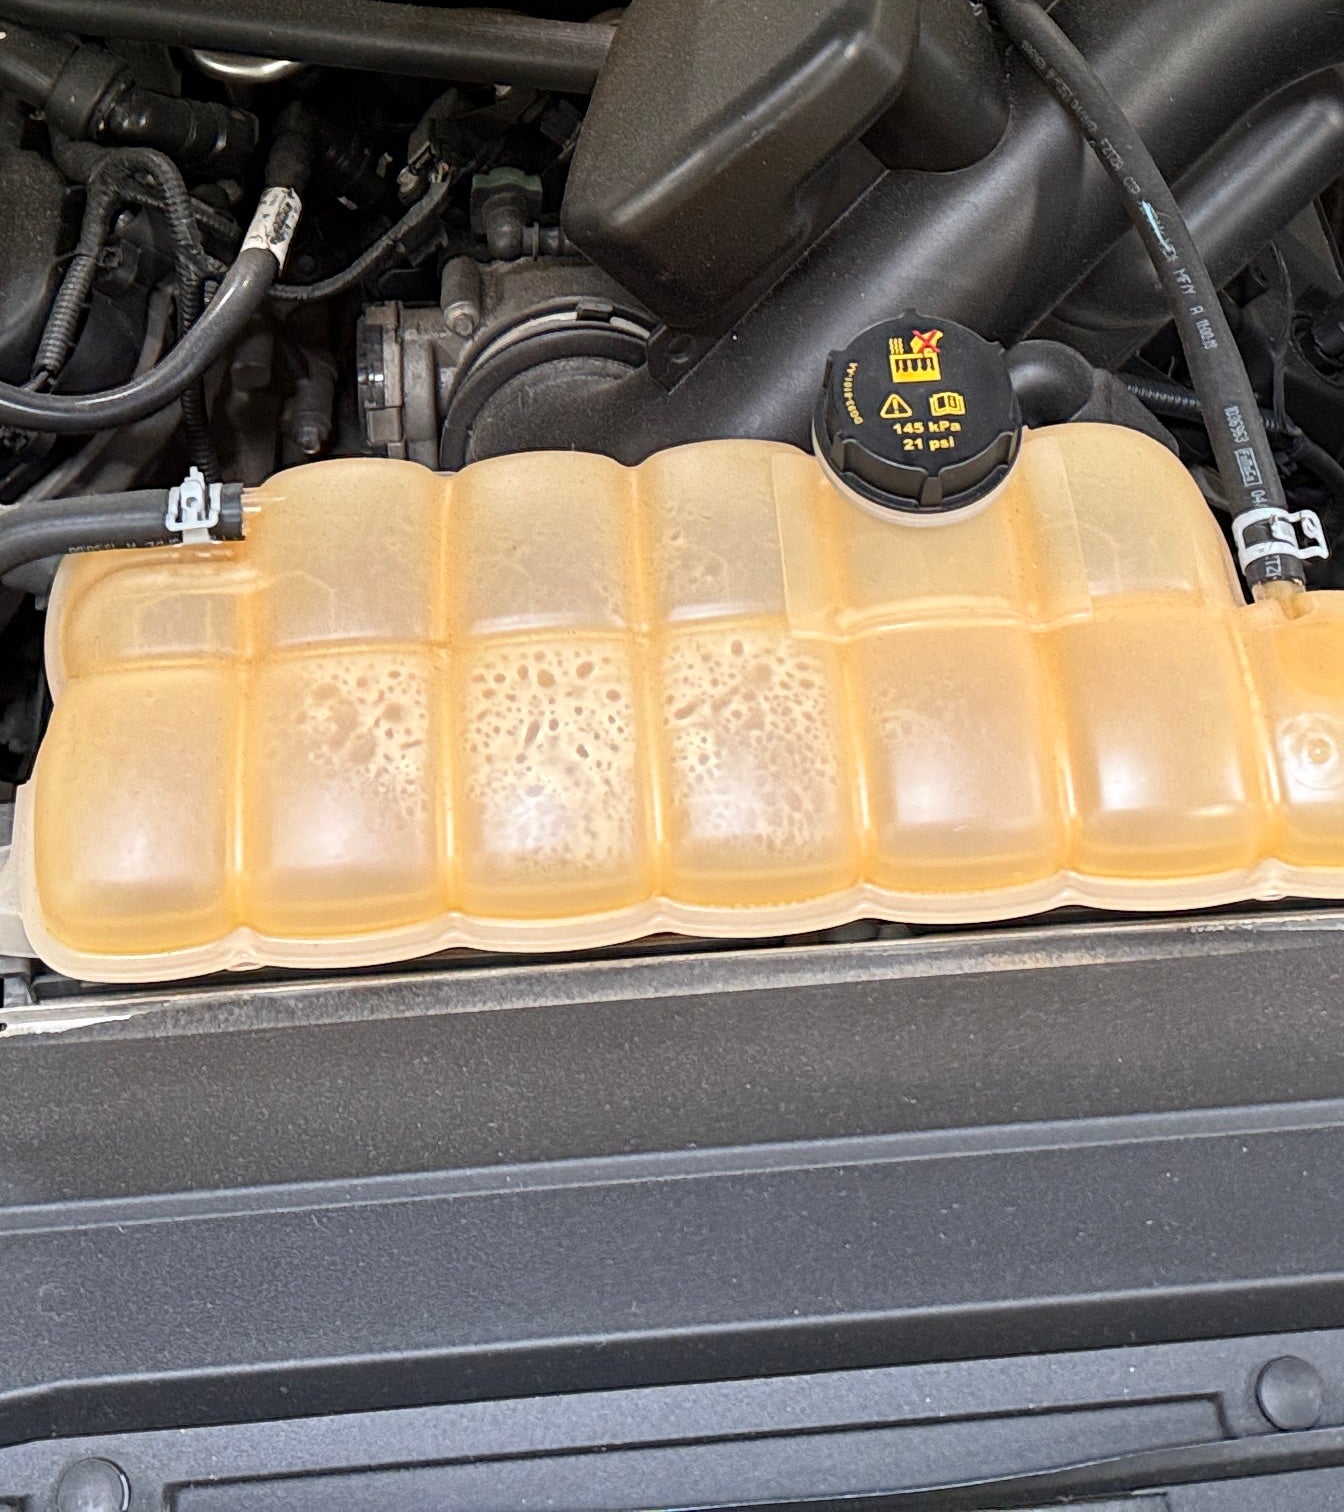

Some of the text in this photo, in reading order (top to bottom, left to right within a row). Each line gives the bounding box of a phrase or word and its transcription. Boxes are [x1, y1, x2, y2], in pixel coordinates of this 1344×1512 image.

[892, 420, 962, 435] 145 kPa
[902, 436, 956, 452] 21 psi
